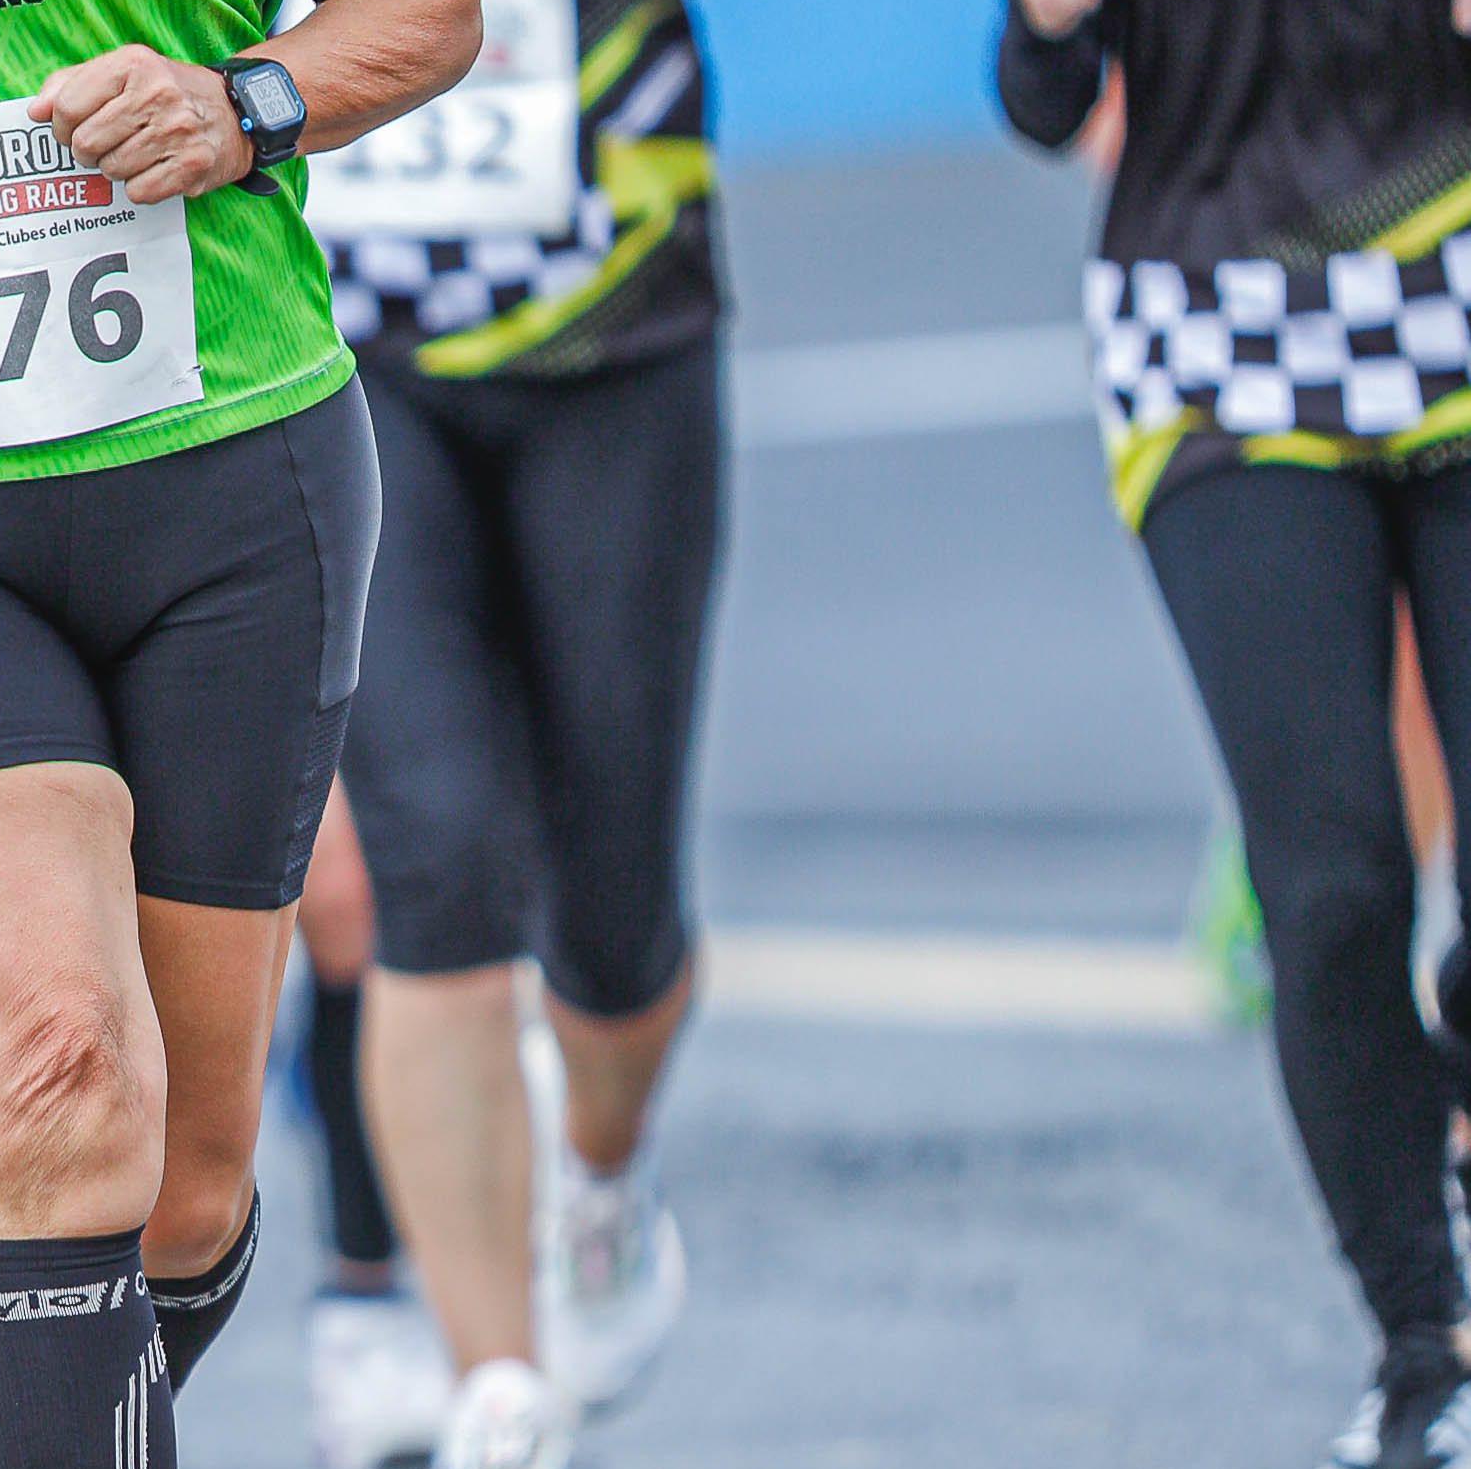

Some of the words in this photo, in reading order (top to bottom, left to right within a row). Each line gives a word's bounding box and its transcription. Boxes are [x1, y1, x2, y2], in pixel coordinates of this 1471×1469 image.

[24, 180, 88, 210] RACE
[49, 220, 71, 237] del
[74, 208, 136, 233] Noroeste
